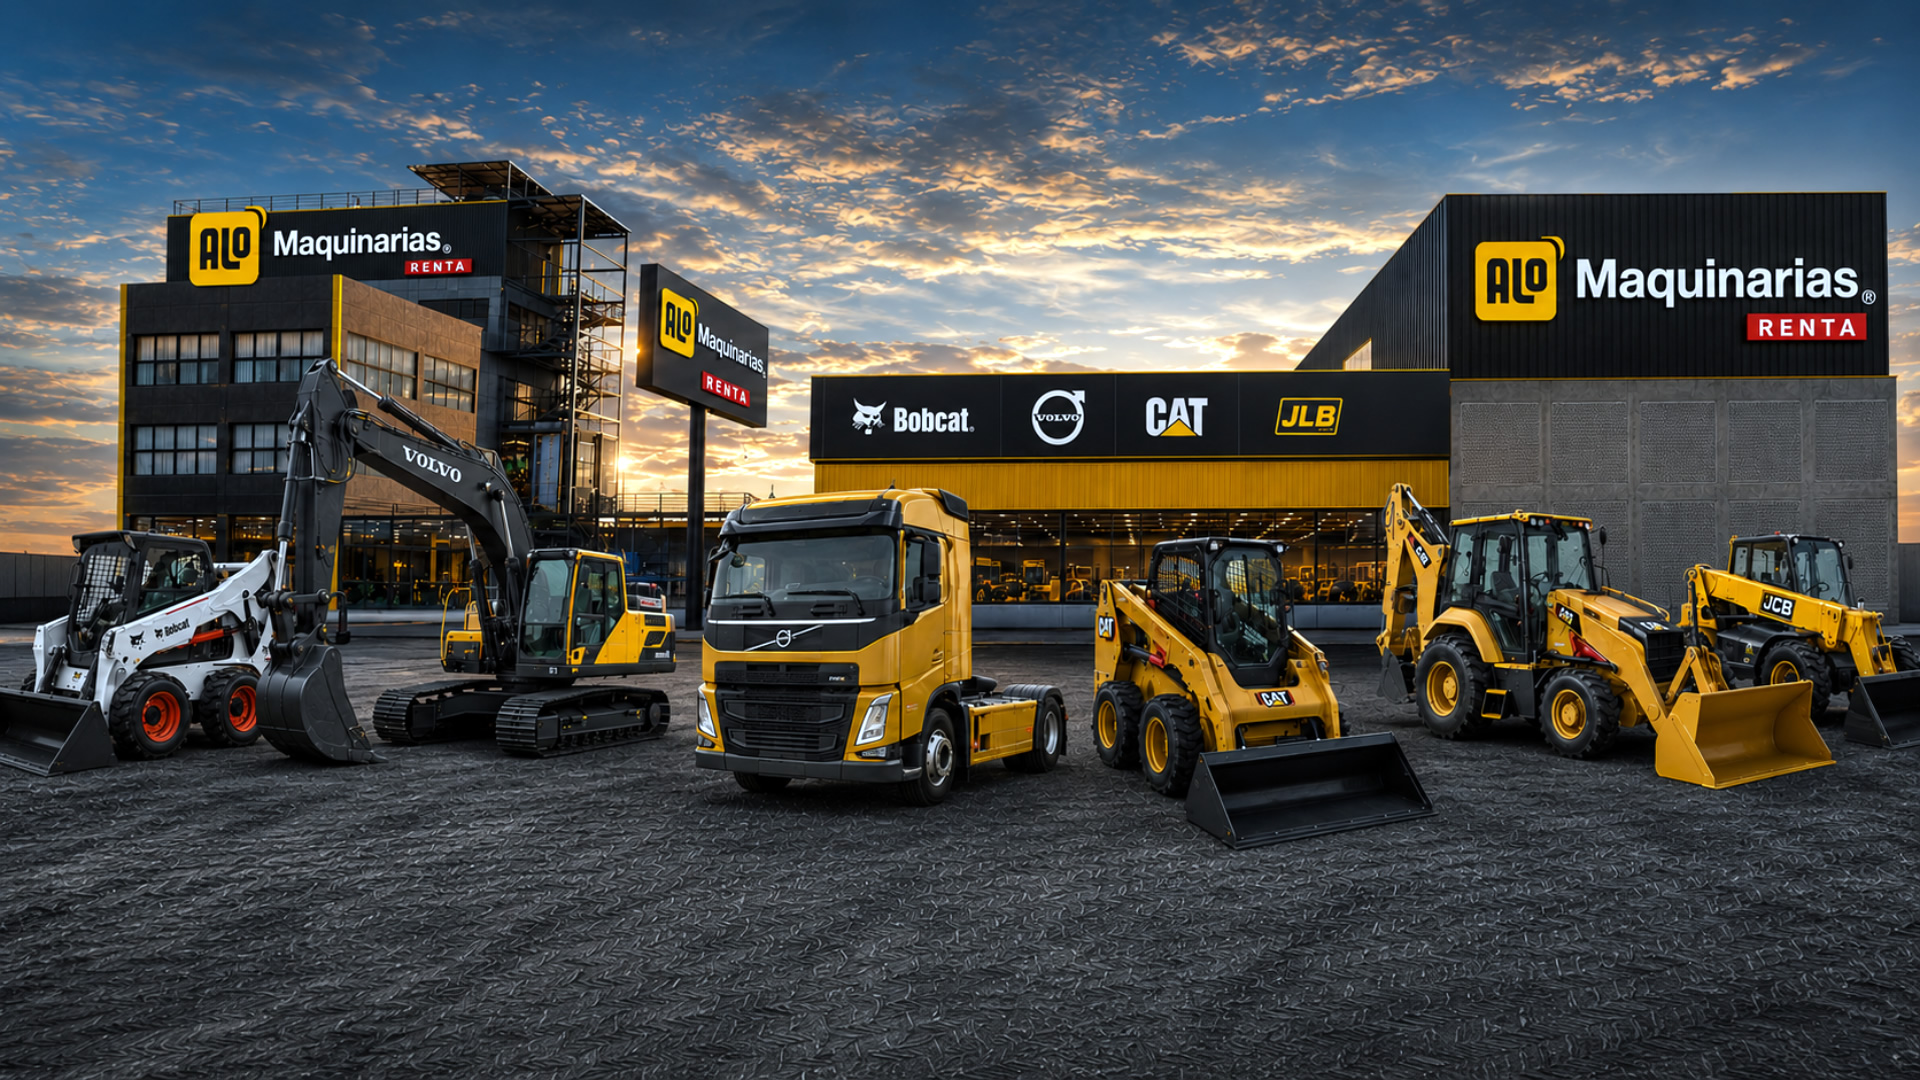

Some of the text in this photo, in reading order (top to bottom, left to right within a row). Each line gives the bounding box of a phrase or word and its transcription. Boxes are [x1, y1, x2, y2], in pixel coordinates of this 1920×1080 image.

[200, 226, 441, 270] ALO Maquinarias
[410, 261, 465, 273] RENTA
[1486, 257, 1859, 308] ALO Maquinarias
[665, 301, 764, 373] ALO Maquinarias
[1758, 318, 1856, 337] RENTA
[706, 375, 747, 404] RENTA
[893, 407, 969, 433] Bobcat
[1036, 413, 1082, 422] VOLVO
[1146, 397, 1209, 437] CAT
[1281, 405, 1337, 427] JLB
[402, 444, 462, 483] VOLVO
[1763, 595, 1793, 616] JCB
[164, 618, 190, 637] Bobcat
[1261, 691, 1289, 707] CAT
